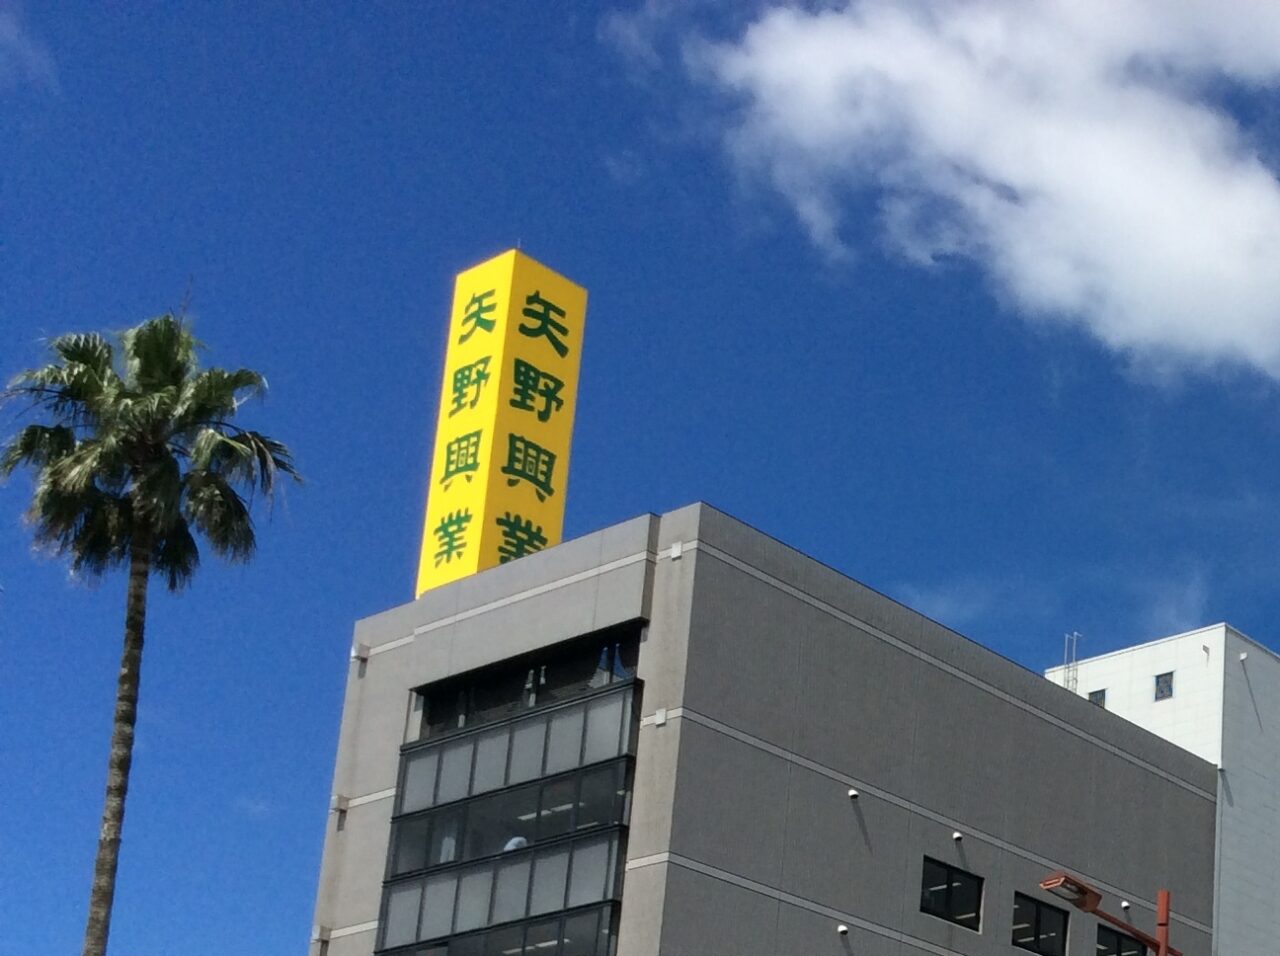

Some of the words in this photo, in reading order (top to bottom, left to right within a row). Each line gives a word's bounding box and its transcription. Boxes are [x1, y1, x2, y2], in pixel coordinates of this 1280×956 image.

[434, 289, 498, 568] 矢野興業
[495, 290, 570, 564] 矢野興業
